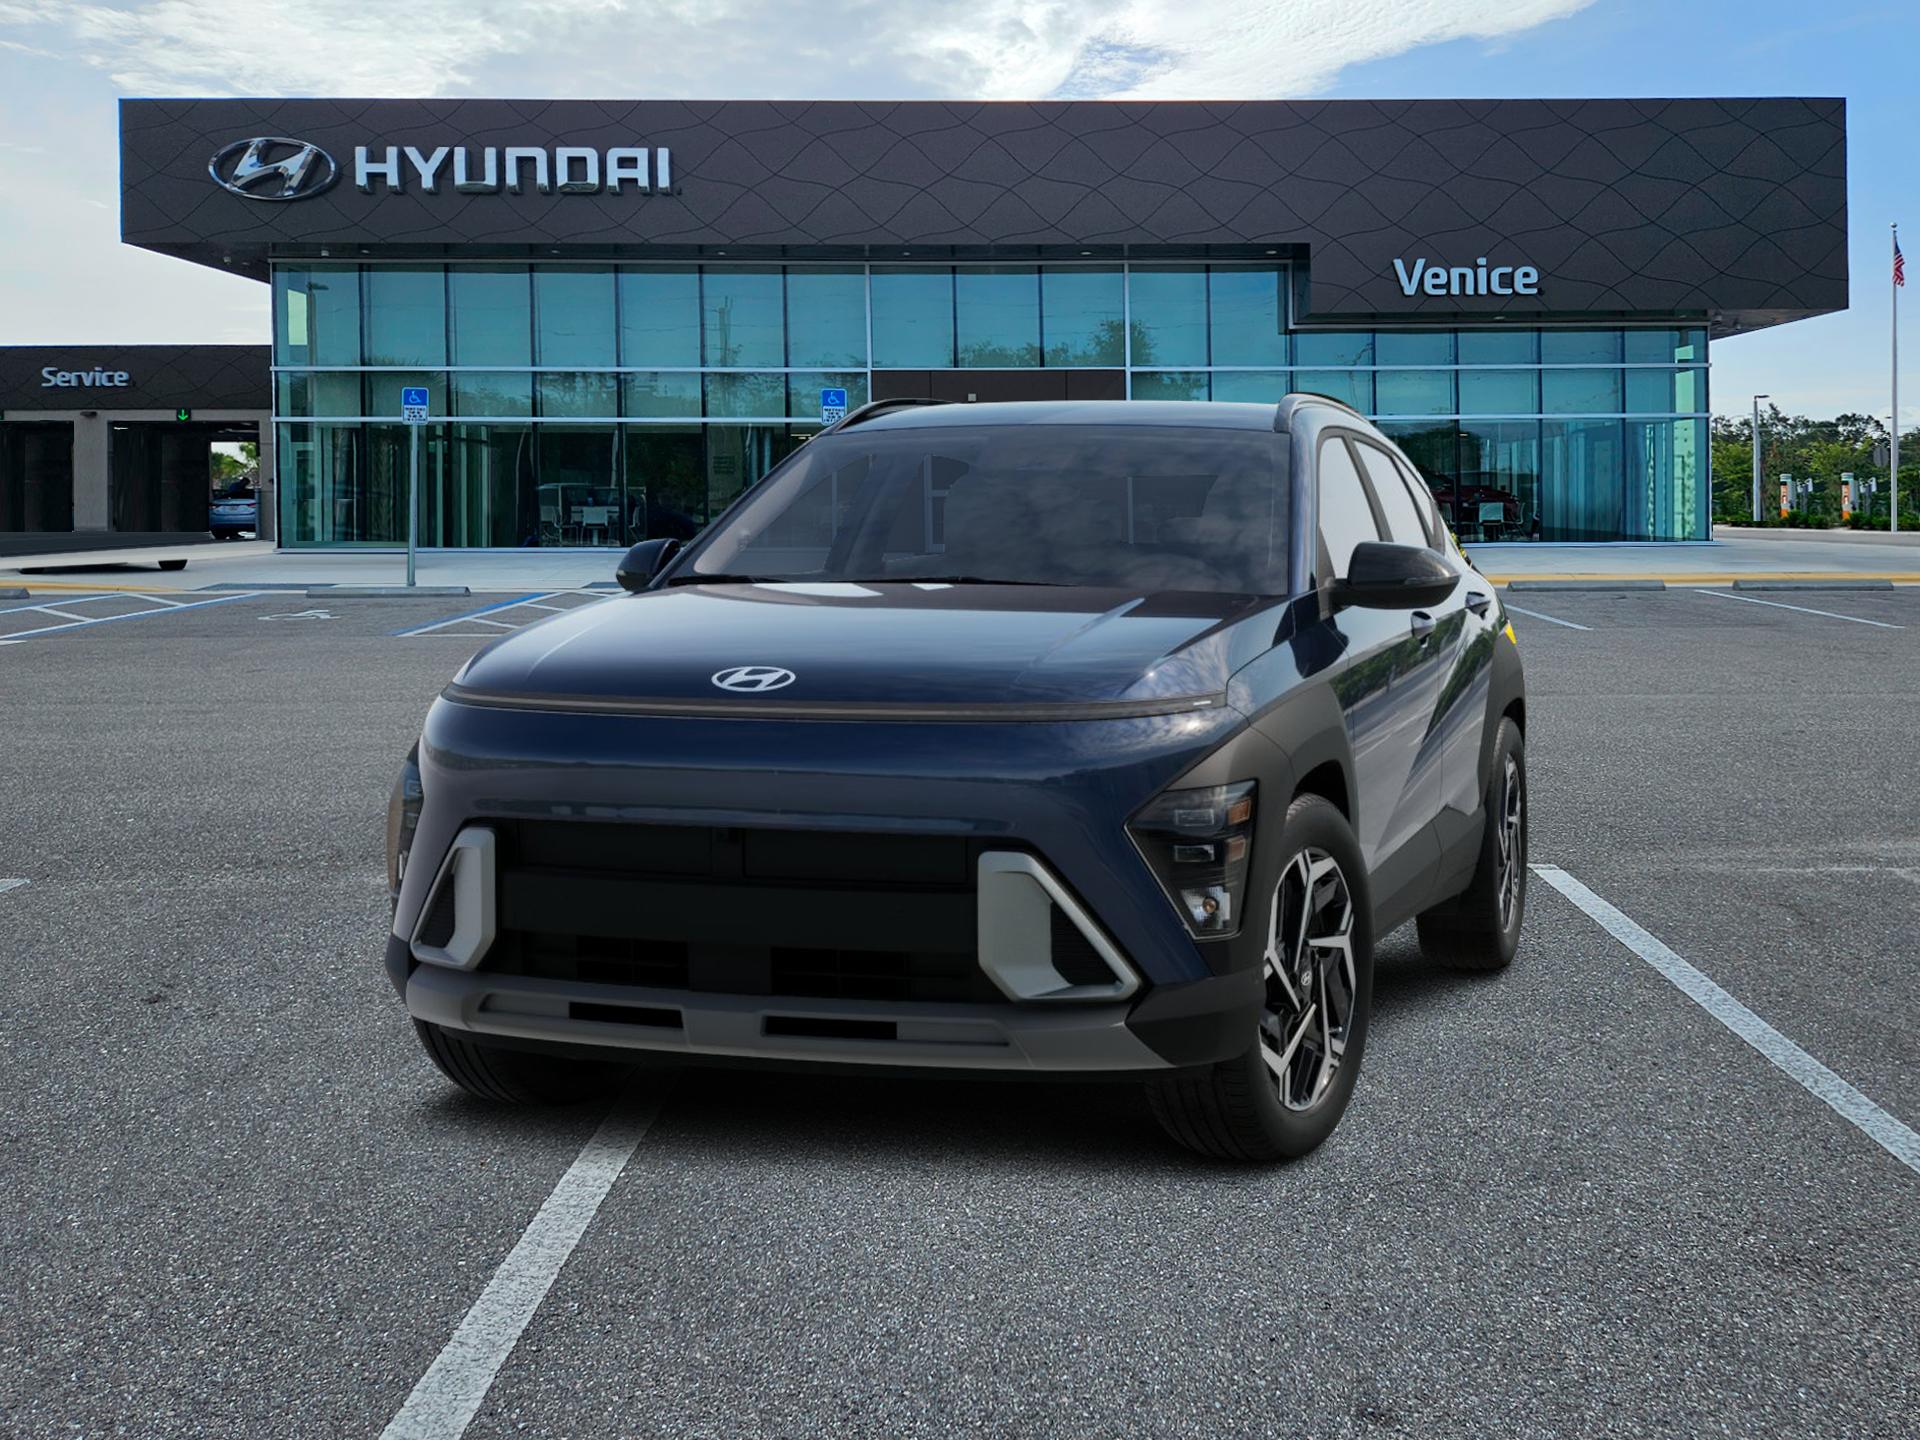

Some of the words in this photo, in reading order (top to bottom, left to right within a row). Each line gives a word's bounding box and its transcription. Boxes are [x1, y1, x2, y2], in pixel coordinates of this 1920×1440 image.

[355, 146, 670, 193] HYUNDAI
[1393, 257, 1539, 296] Venice
[41, 366, 129, 387] Service
